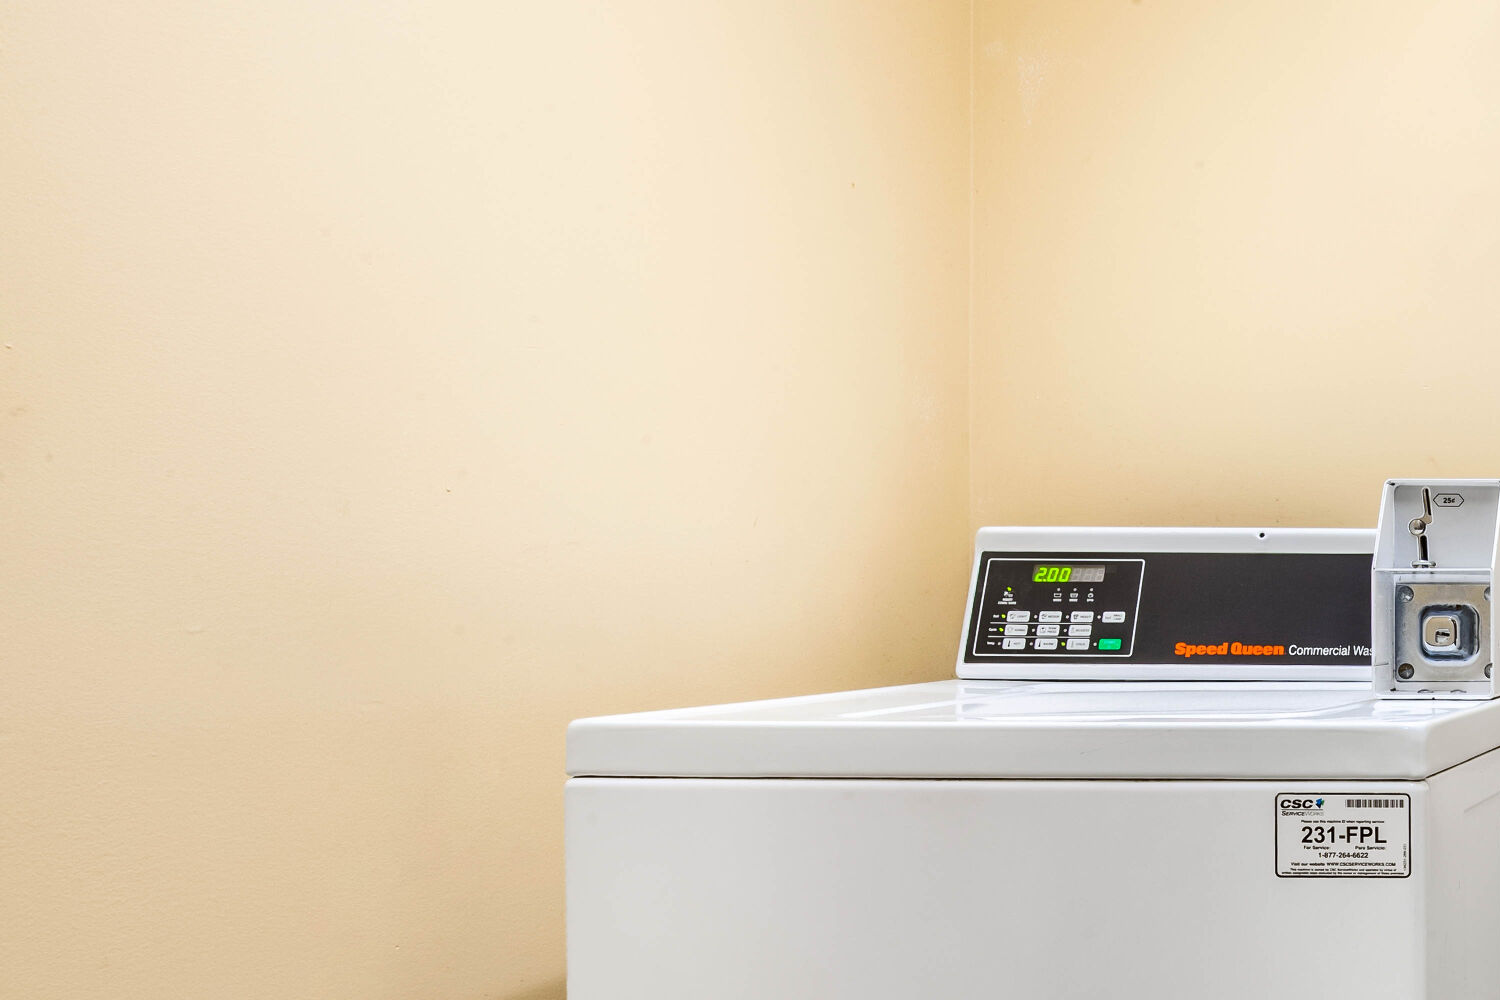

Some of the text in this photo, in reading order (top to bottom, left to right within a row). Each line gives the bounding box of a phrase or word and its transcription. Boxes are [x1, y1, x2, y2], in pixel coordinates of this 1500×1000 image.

[1034, 566, 1072, 583] 2.00
[1174, 641, 1229, 658] Speed
[1230, 641, 1285, 656] Queen
[1288, 644, 1350, 656] Commercial
[1280, 799, 1314, 809] CSC
[1301, 826, 1387, 844] 231-FPL
